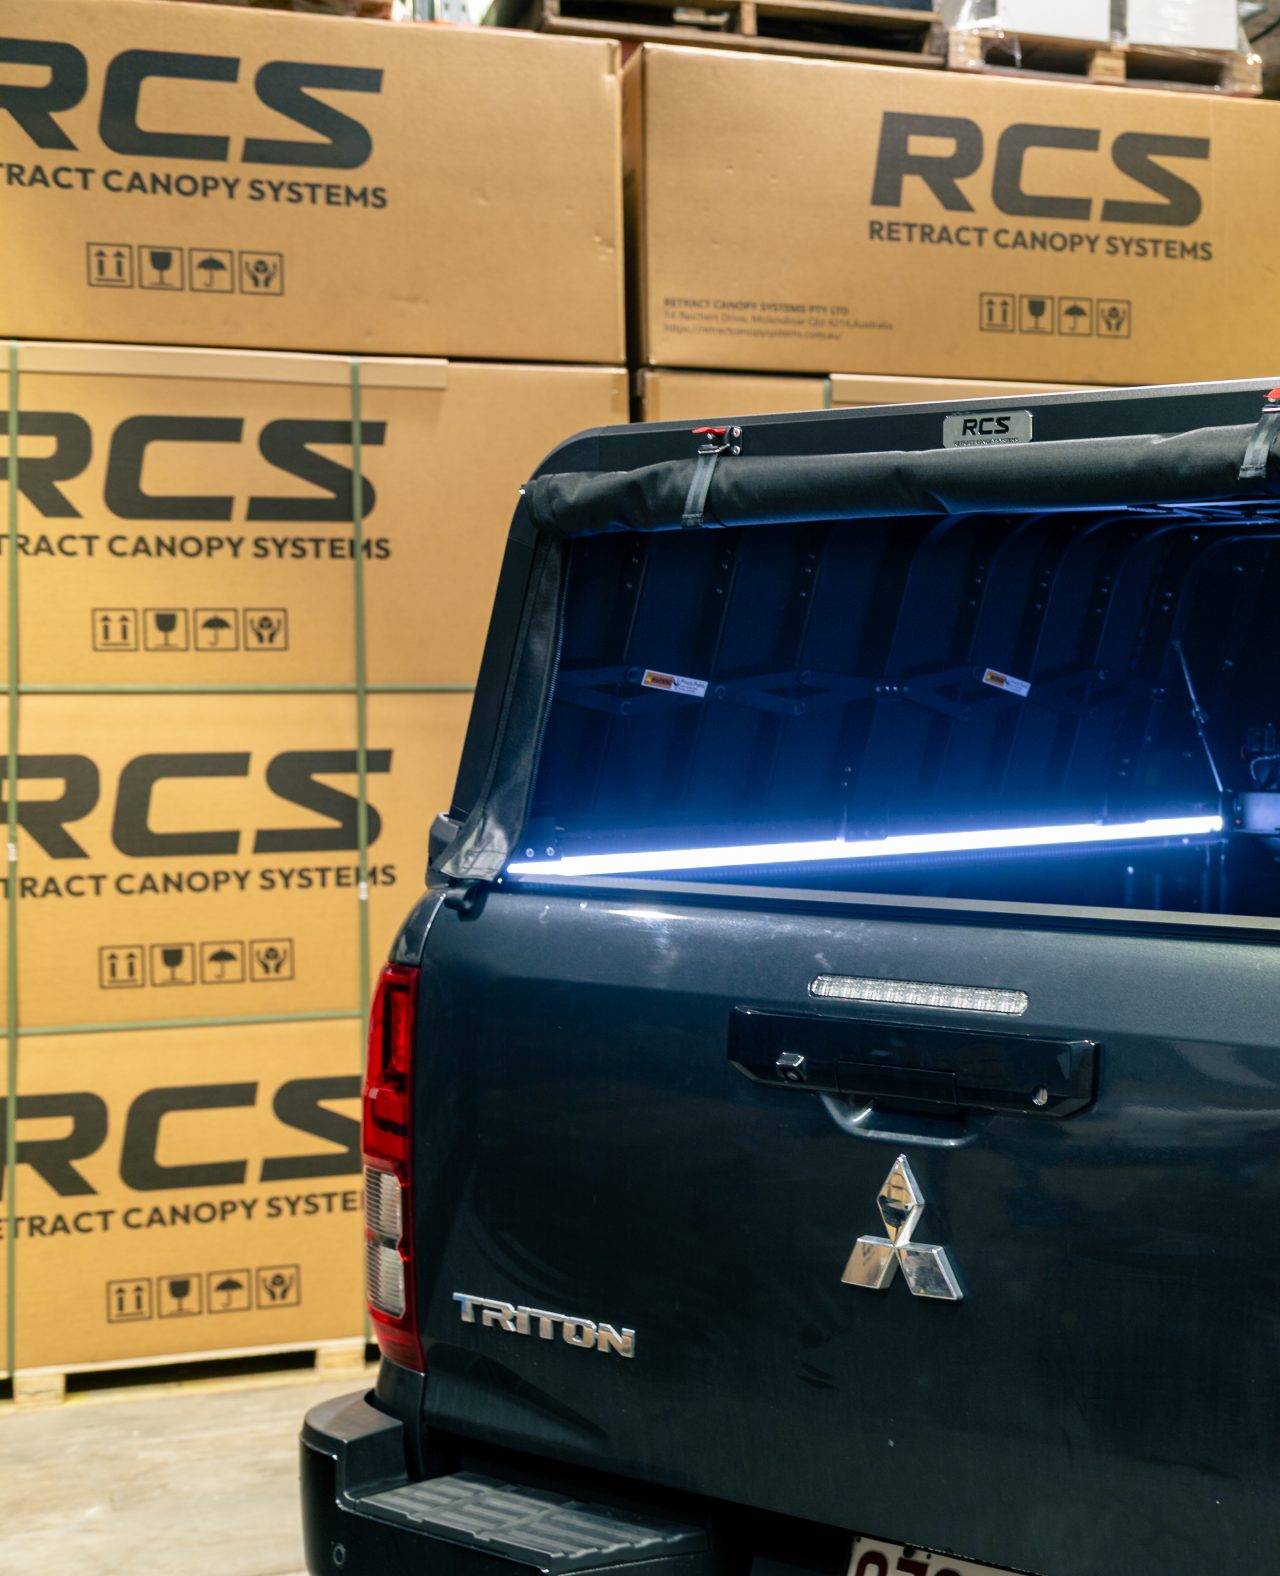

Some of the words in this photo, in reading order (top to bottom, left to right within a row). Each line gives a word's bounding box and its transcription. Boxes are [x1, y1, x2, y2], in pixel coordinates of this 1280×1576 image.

[0, 37, 384, 170] RCS
[0, 162, 96, 191] RACT
[102, 169, 241, 200] CANOPY
[248, 178, 388, 210] SYSTEMS
[870, 111, 1211, 227] RCS
[868, 219, 989, 248] RETRACT
[993, 228, 1100, 254] CANOPY
[1105, 235, 1213, 261] SYSTEMS
[664, 297, 711, 309] RETRACT
[713, 299, 757, 311] CANOPY
[760, 302, 806, 314] SYSTEMS
[962, 416, 1011, 436] RCS
[0, 411, 388, 522] RCS
[107, 534, 246, 558] CANOPY
[253, 536, 391, 560] SYSTEMS
[0, 749, 394, 859] RCS
[114, 869, 252, 896] CANOPY
[259, 864, 397, 891] SYSTEMS
[0, 1075, 362, 1198] RCS
[122, 1198, 259, 1230] CANOPY
[266, 1190, 364, 1219] SYSTE
[452, 1292, 636, 1359] TRITON
